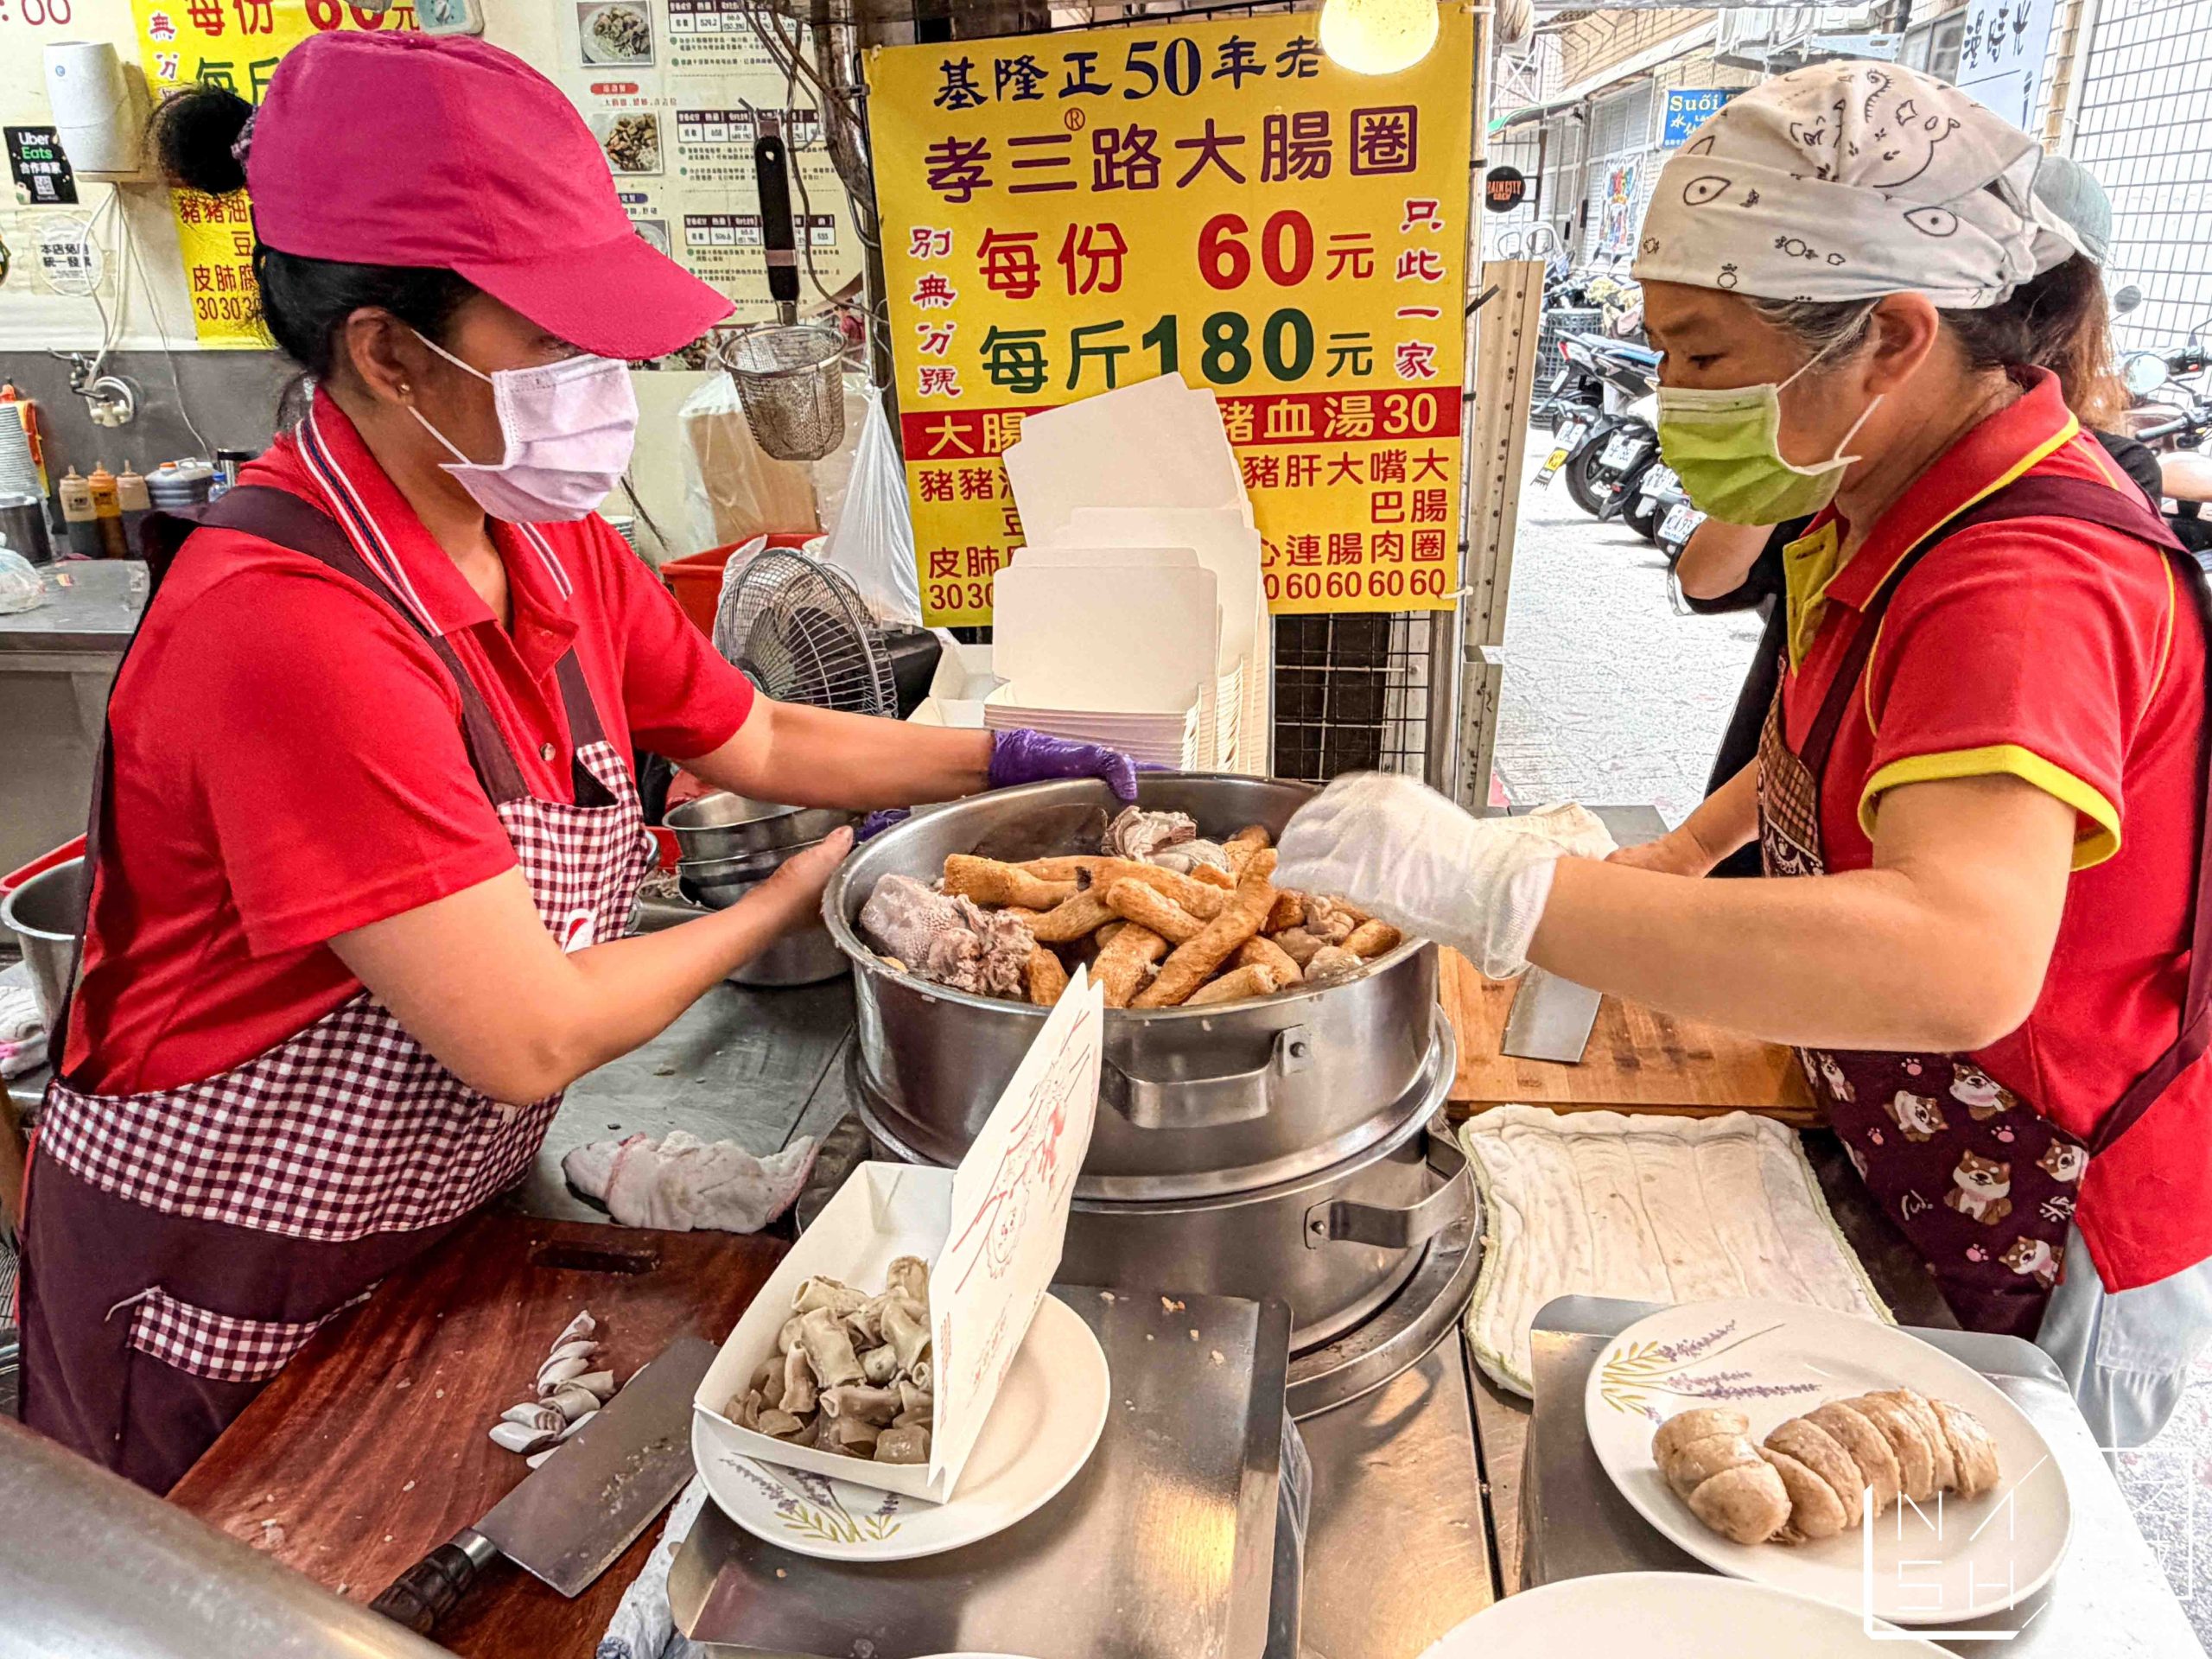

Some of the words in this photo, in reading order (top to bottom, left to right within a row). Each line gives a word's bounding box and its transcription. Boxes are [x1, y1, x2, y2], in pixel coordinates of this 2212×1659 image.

[149, 12, 178, 98] 無分
[188, 0, 273, 36] 每份
[18, 131, 49, 145] Uber
[21, 146, 53, 160] Eats
[924, 105, 1418, 203] 孝三路大腸圈
[976, 222, 1128, 300] 每份
[1396, 200, 1444, 378] 只此一家
[910, 228, 962, 396] 別無分號
